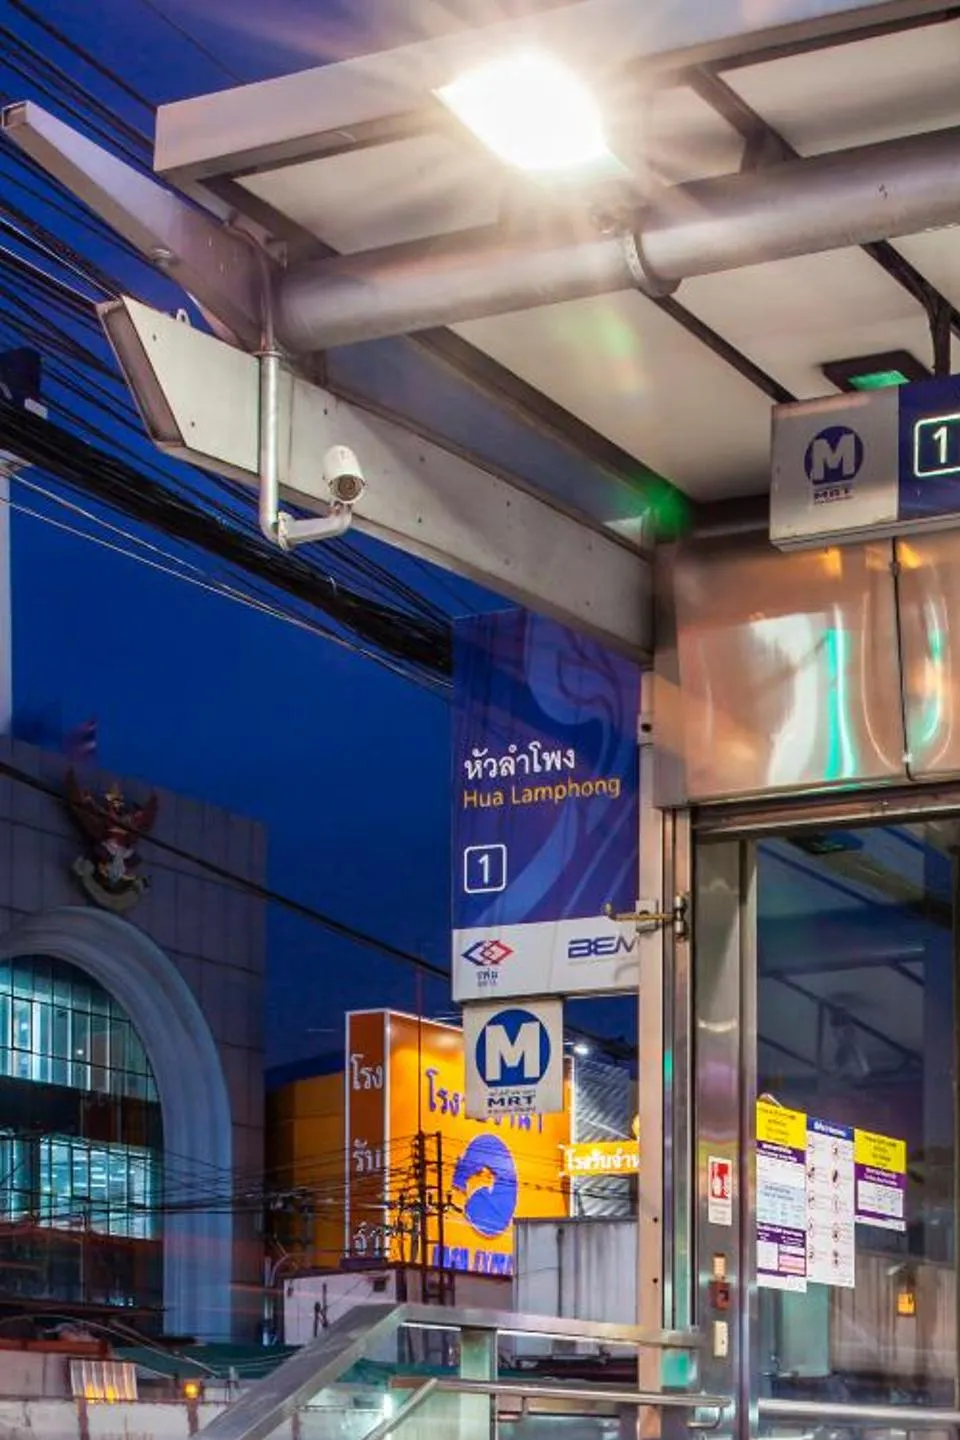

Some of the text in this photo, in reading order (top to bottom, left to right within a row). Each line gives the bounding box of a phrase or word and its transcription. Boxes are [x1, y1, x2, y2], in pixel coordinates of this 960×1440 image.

[811, 432, 856, 481] M
[932, 425, 948, 464] 1
[463, 740, 576, 781] หัวลำโพง
[463, 776, 621, 809] Hua Lamphong
[478, 853, 491, 884] 1
[484, 1021, 541, 1082] M
[487, 1095, 536, 1108] MRT
